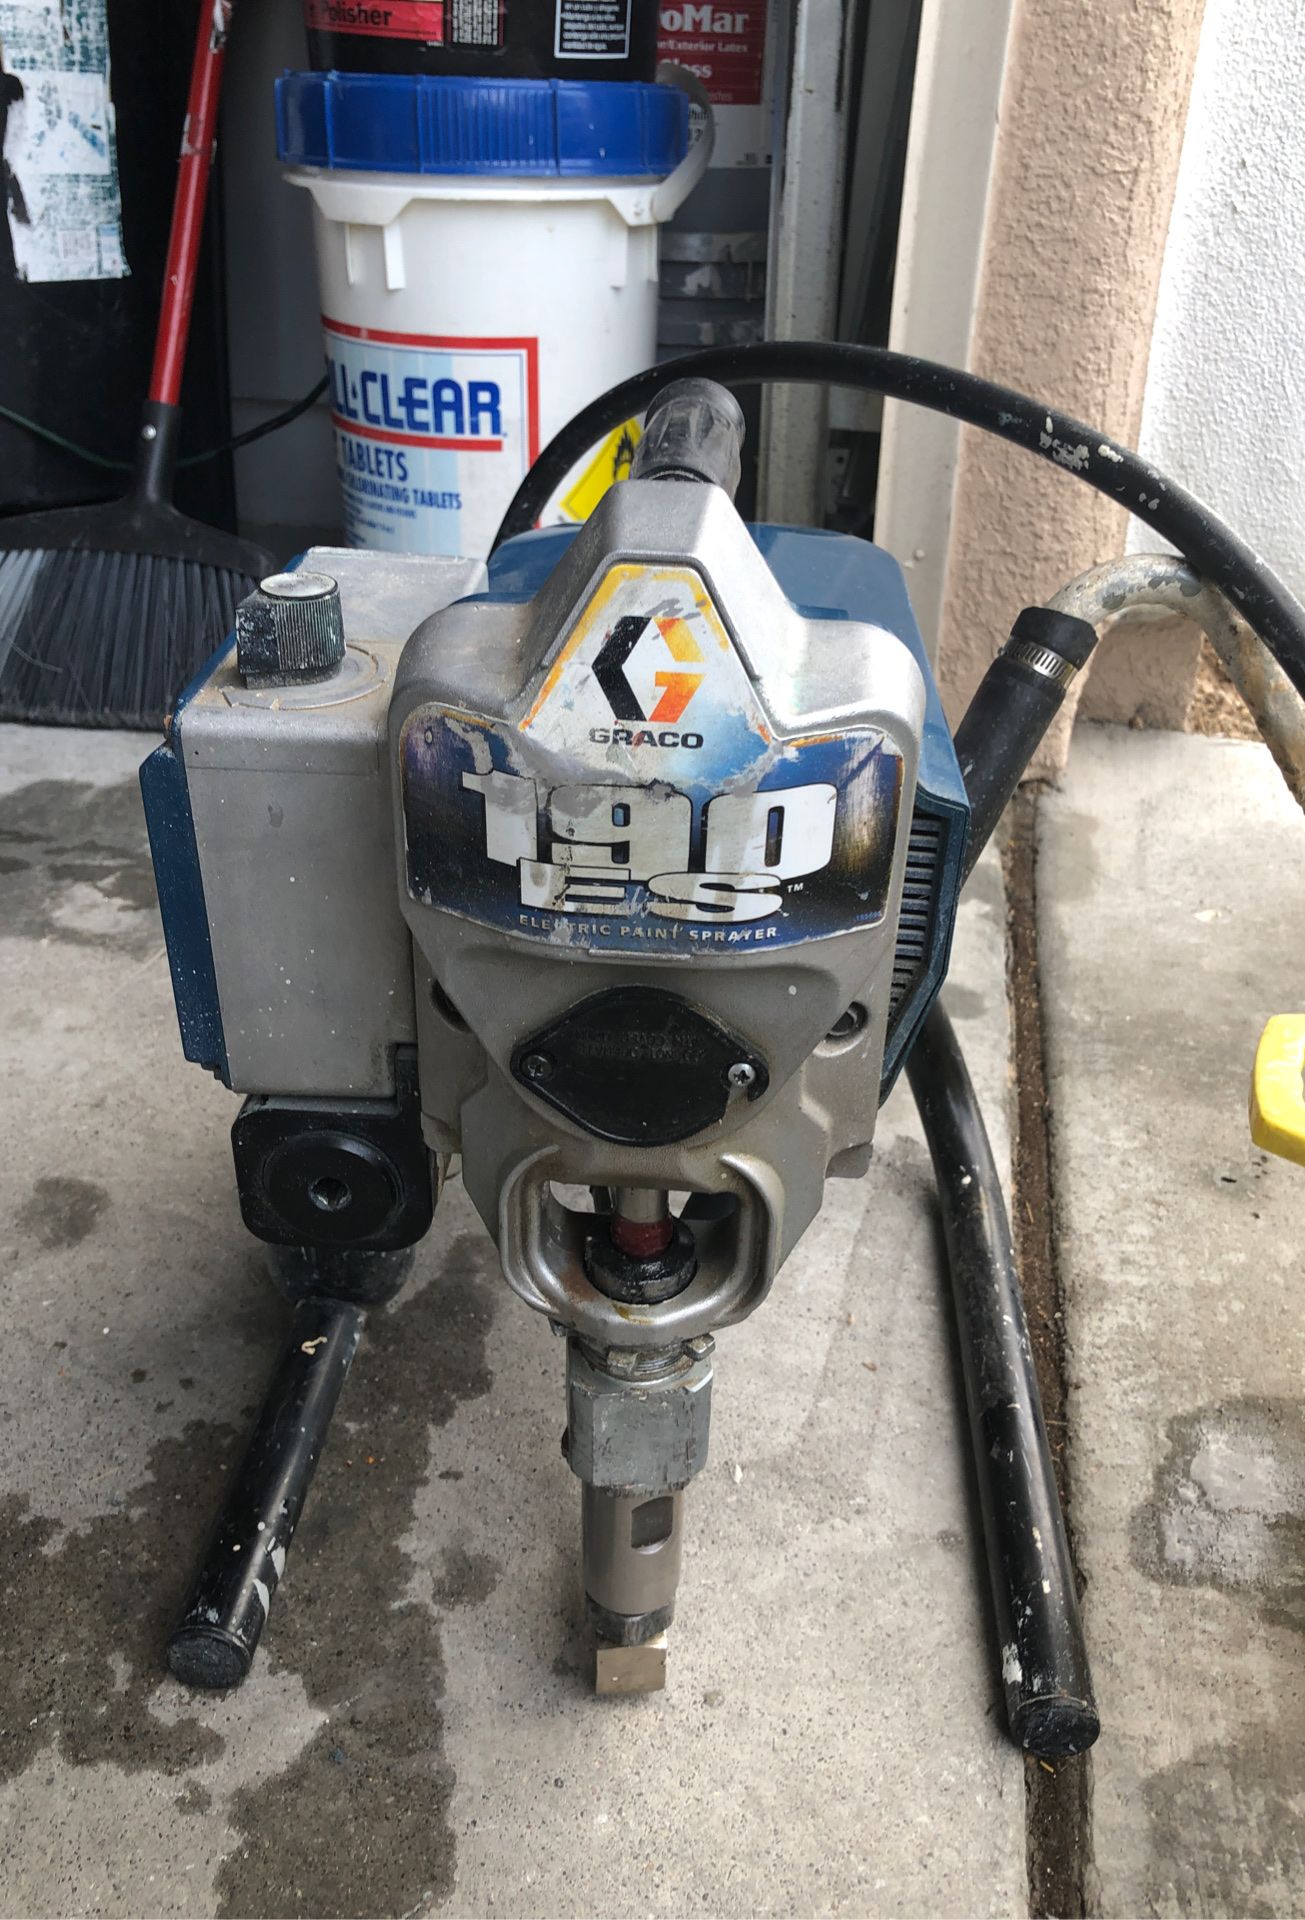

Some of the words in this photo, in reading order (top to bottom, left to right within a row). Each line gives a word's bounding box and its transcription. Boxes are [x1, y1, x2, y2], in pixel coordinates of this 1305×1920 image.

[341, 435, 408, 482] TABLETS
[413, 488, 462, 510] TABLETS
[588, 727, 704, 749] GRACO
[462, 768, 838, 882] 190
[518, 858, 783, 922] ES
[519, 914, 611, 936] ELETRIC
[619, 924, 683, 939] PAINT
[689, 926, 777, 942] SPRAYER
